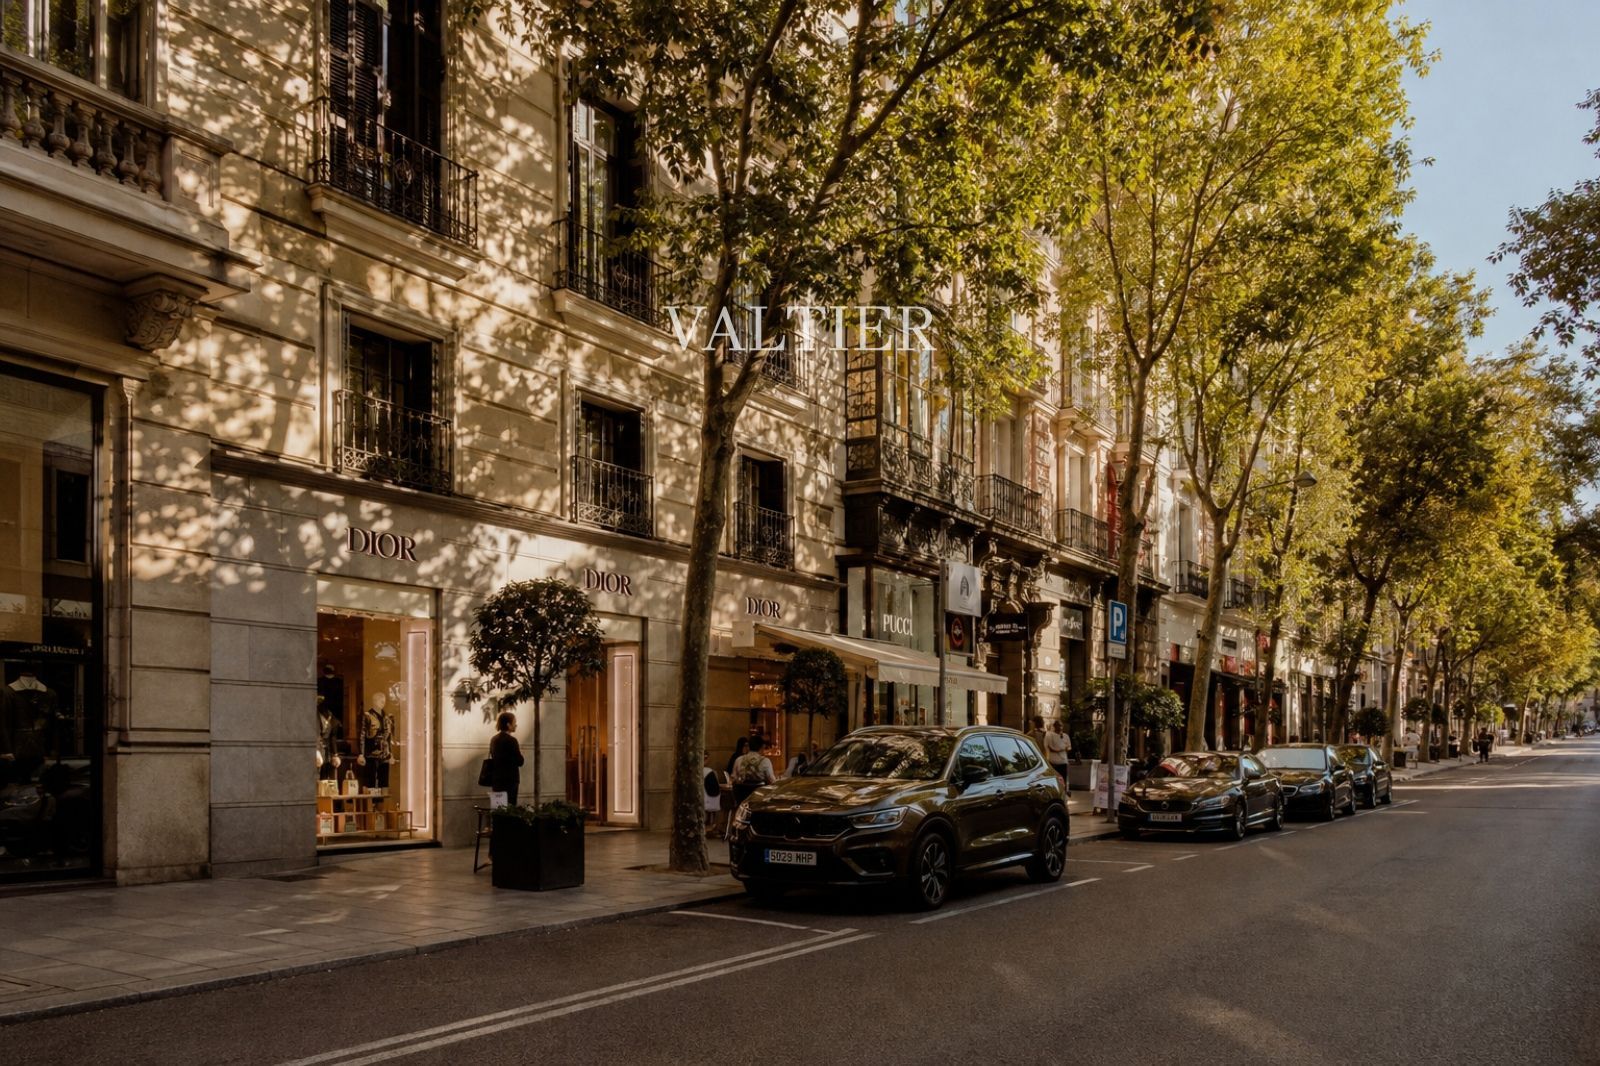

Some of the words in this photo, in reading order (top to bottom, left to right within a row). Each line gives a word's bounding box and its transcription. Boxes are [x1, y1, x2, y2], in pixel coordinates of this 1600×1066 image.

[345, 527, 418, 562] DIOR
[583, 568, 632, 597] DIOR
[745, 596, 781, 619] DIOR
[1113, 606, 1123, 637] P
[883, 613, 913, 636] PUCCI
